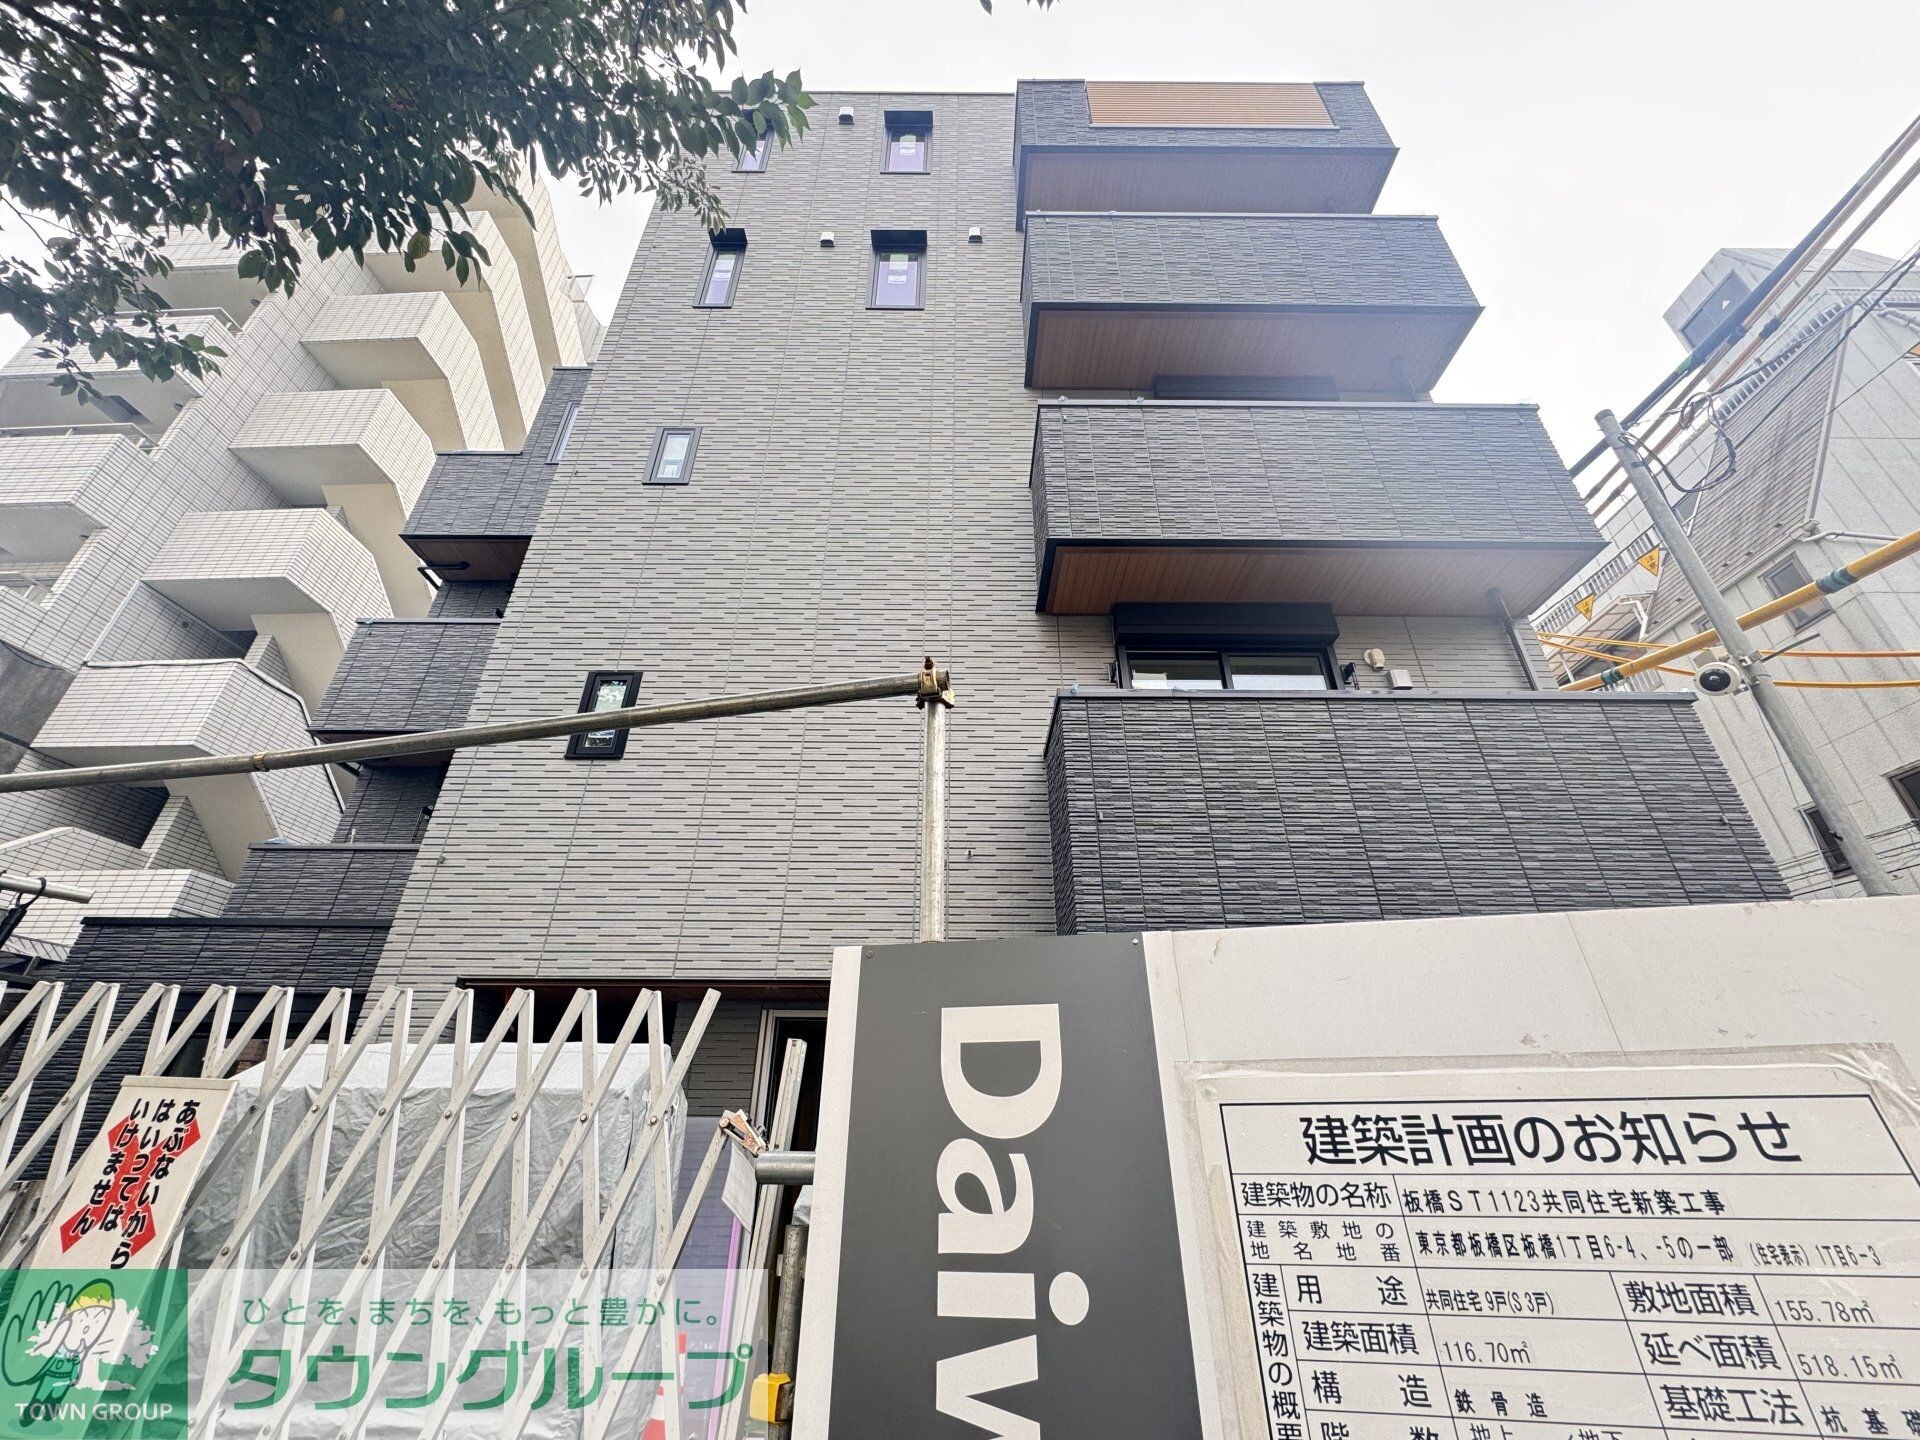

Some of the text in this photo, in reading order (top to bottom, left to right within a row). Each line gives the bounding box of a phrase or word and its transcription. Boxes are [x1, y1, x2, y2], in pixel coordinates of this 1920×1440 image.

[1299, 1111, 1803, 1167] 建築計画のお知らせ
[71, 1098, 149, 1236] いけません
[99, 1098, 175, 1232] はいっては
[111, 1099, 200, 1270] あぶないから
[1241, 1181, 1391, 1209] 建築物の名称
[1246, 1220, 1394, 1240] 建築敷地の
[1622, 1281, 1759, 1317] 敷地面積
[1301, 1320, 1420, 1356] 建築面積
[1640, 1331, 1782, 1371] 延べ面積
[1659, 1384, 1804, 1426] 基礎工法
